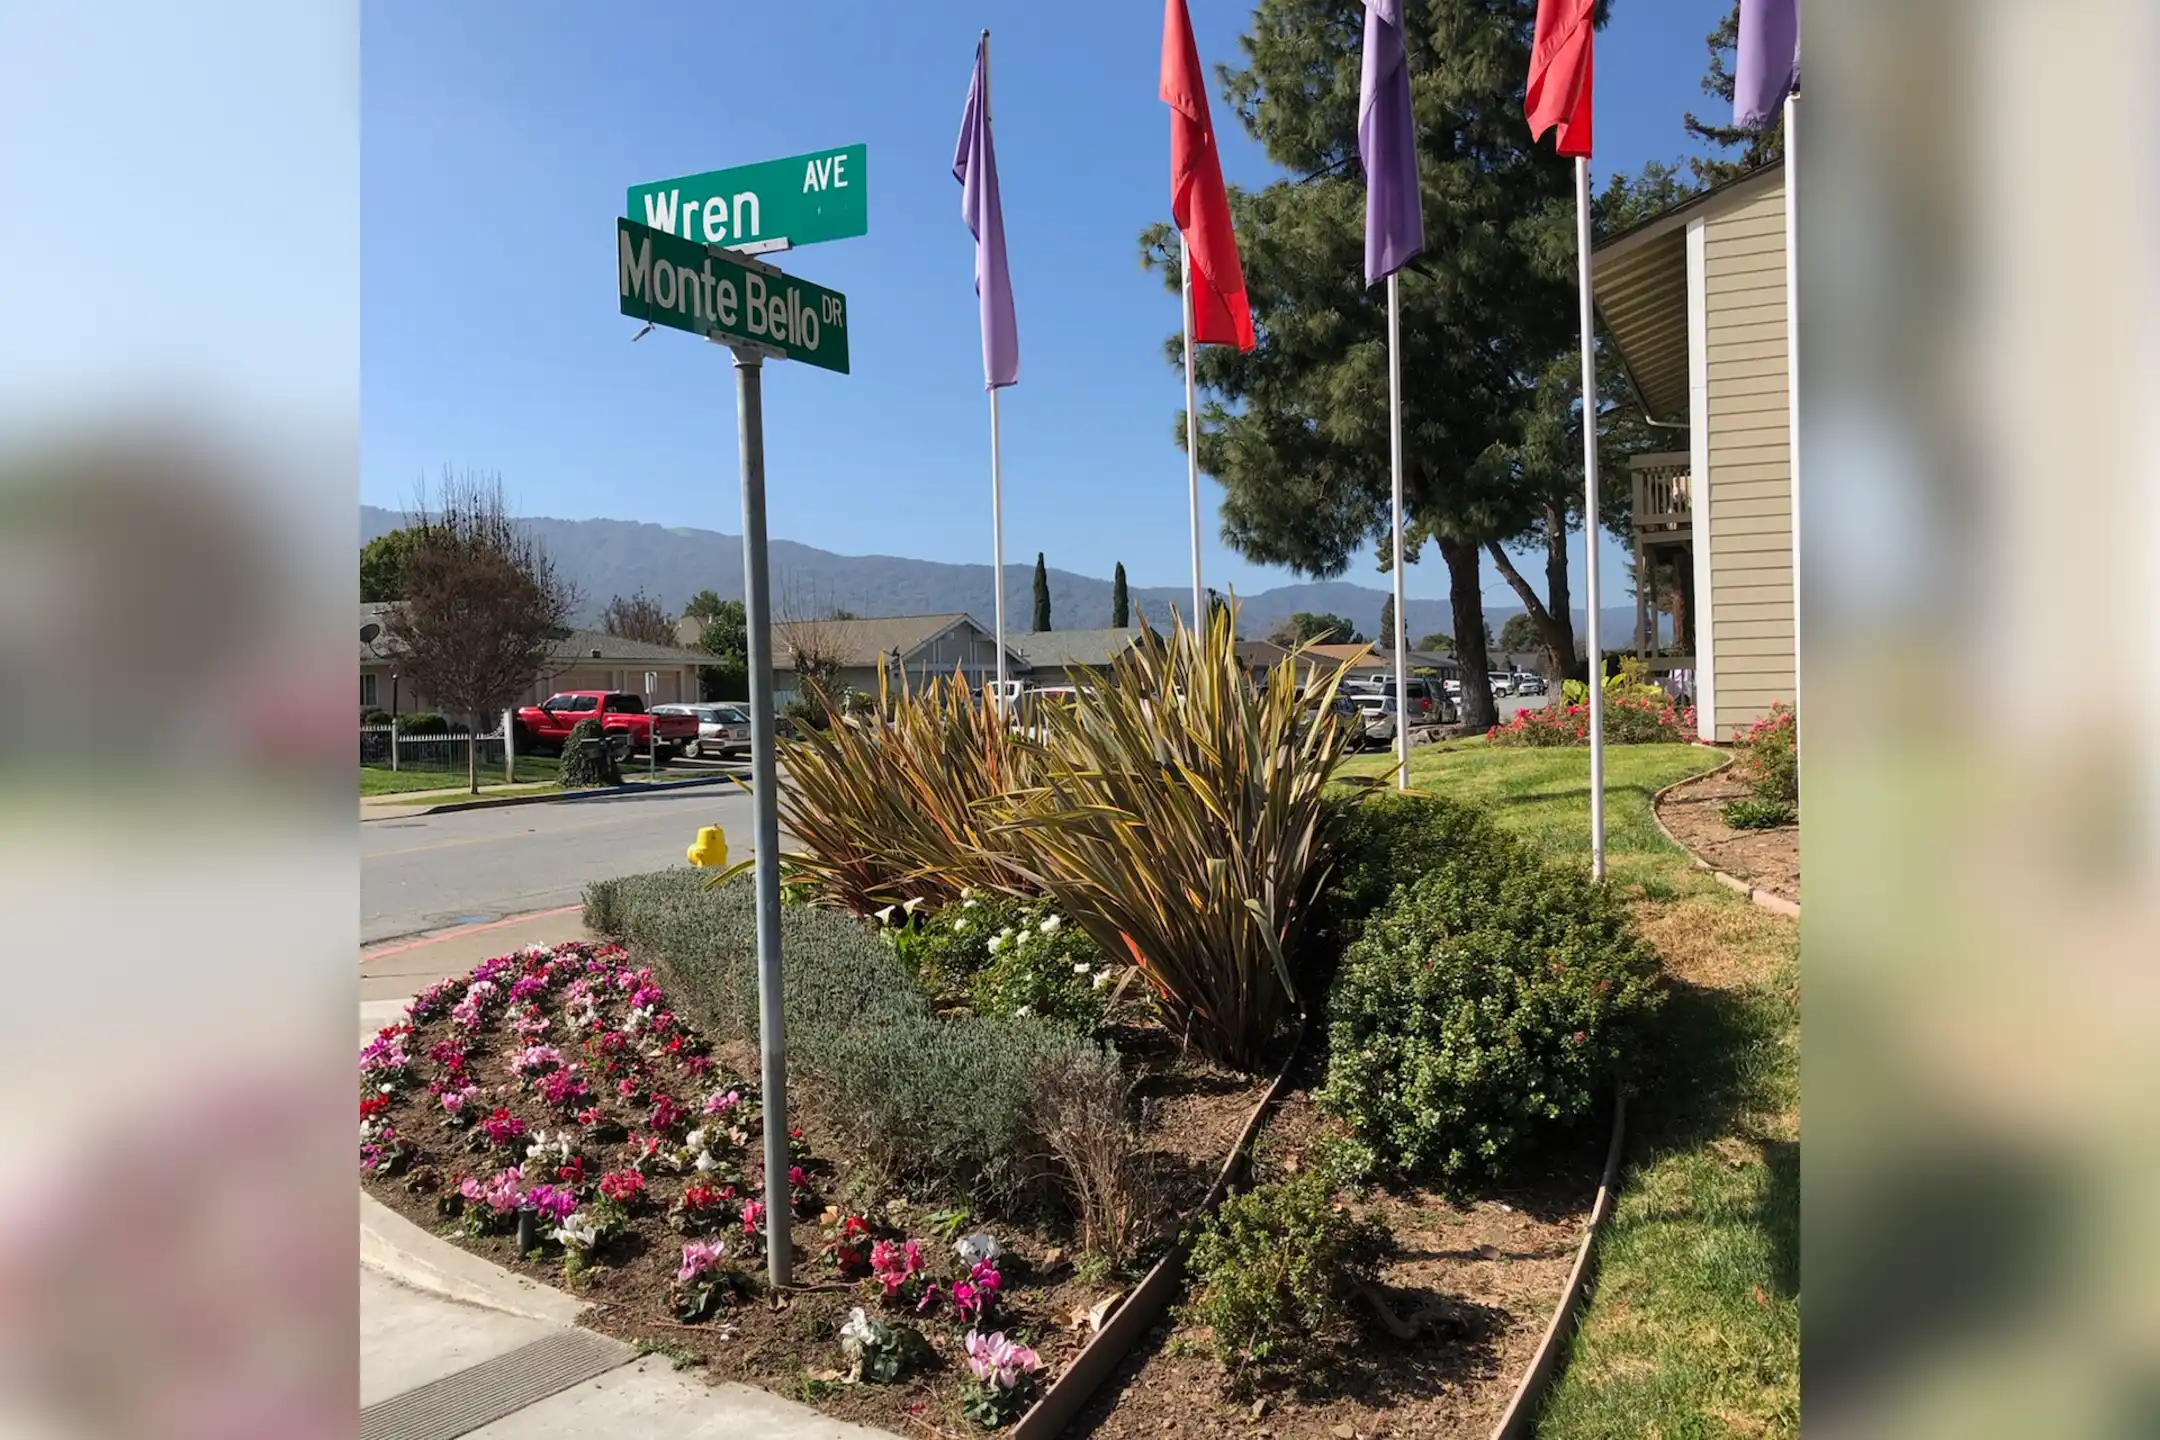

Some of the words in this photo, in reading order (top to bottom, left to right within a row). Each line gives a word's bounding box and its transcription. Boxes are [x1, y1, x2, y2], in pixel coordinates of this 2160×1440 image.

[644, 189, 760, 242] Wren
[803, 154, 848, 193] AVE
[620, 230, 738, 326] Monte
[745, 271, 820, 351] Bello
[821, 294, 843, 327] DR
